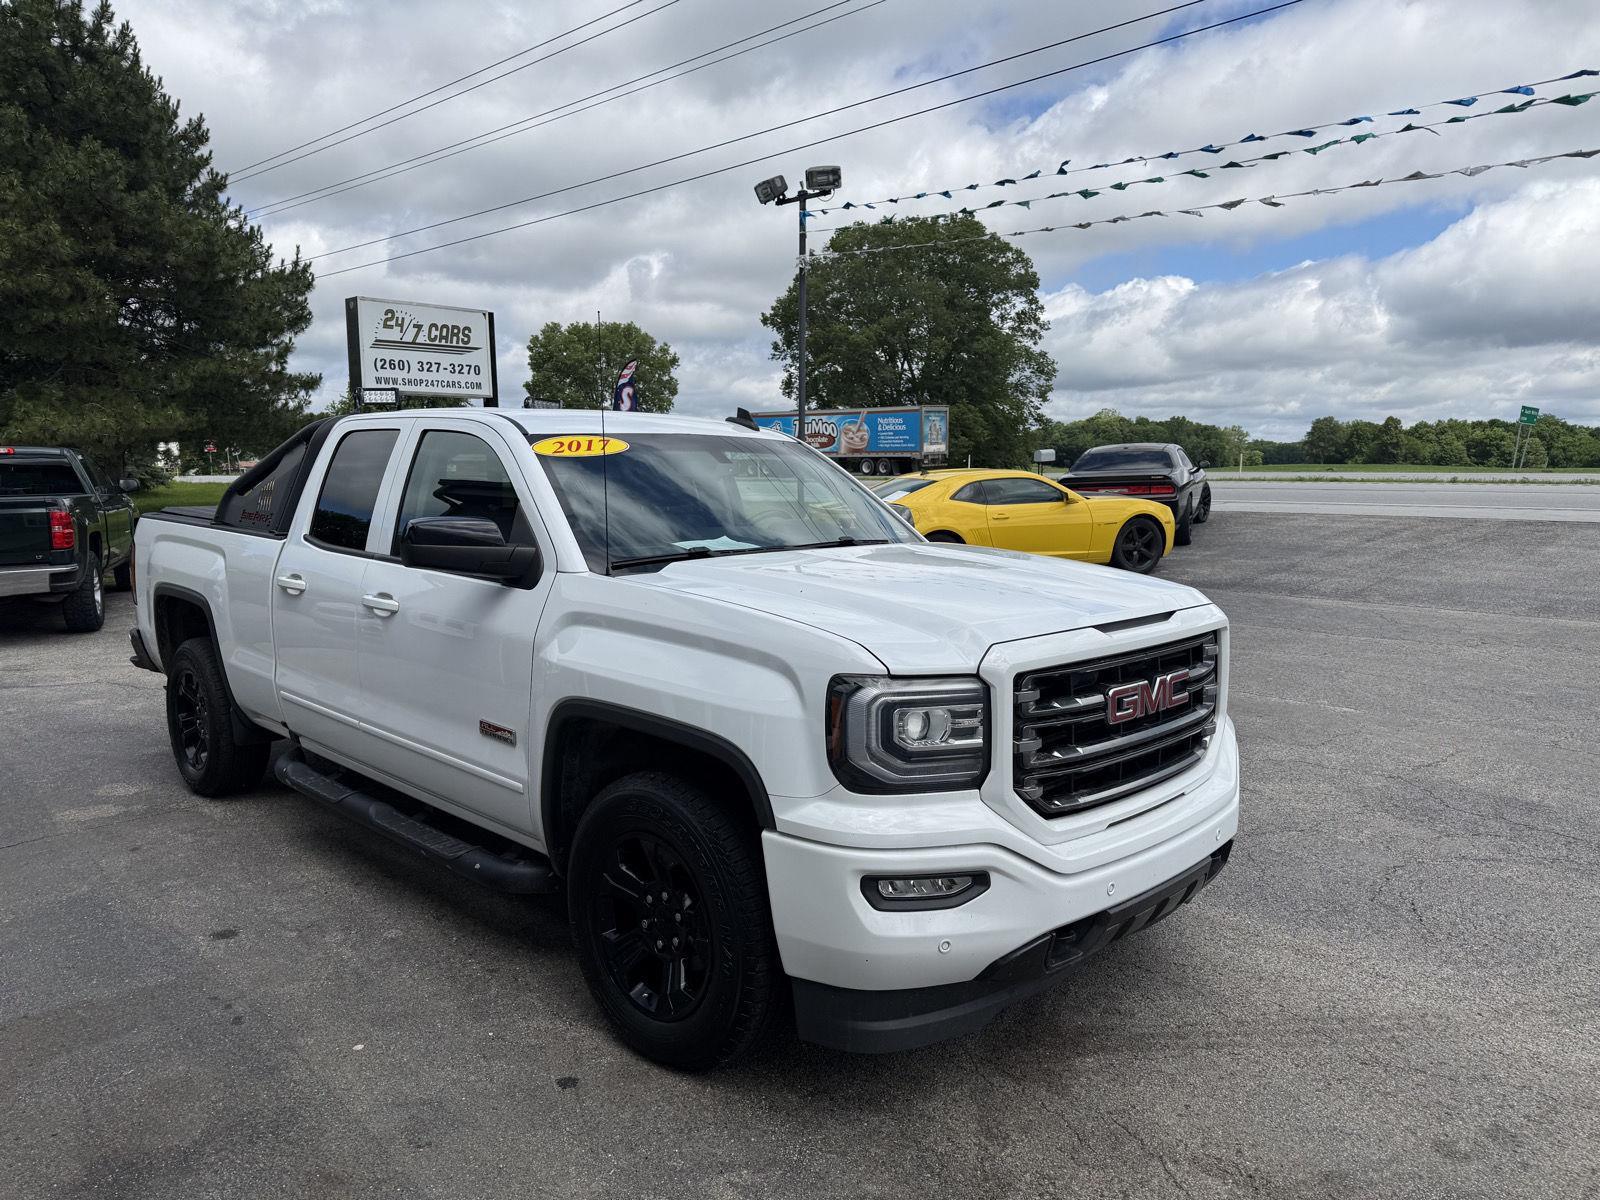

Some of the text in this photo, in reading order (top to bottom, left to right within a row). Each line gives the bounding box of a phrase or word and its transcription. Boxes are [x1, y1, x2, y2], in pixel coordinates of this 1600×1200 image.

[382, 308, 472, 345] 24/7 CARS
[373, 358, 481, 376] (260) 327-3270
[374, 376, 483, 390] WWW.SHOP247CARS.COM
[552, 439, 611, 454] 2017
[1107, 668, 1190, 725] GMC
